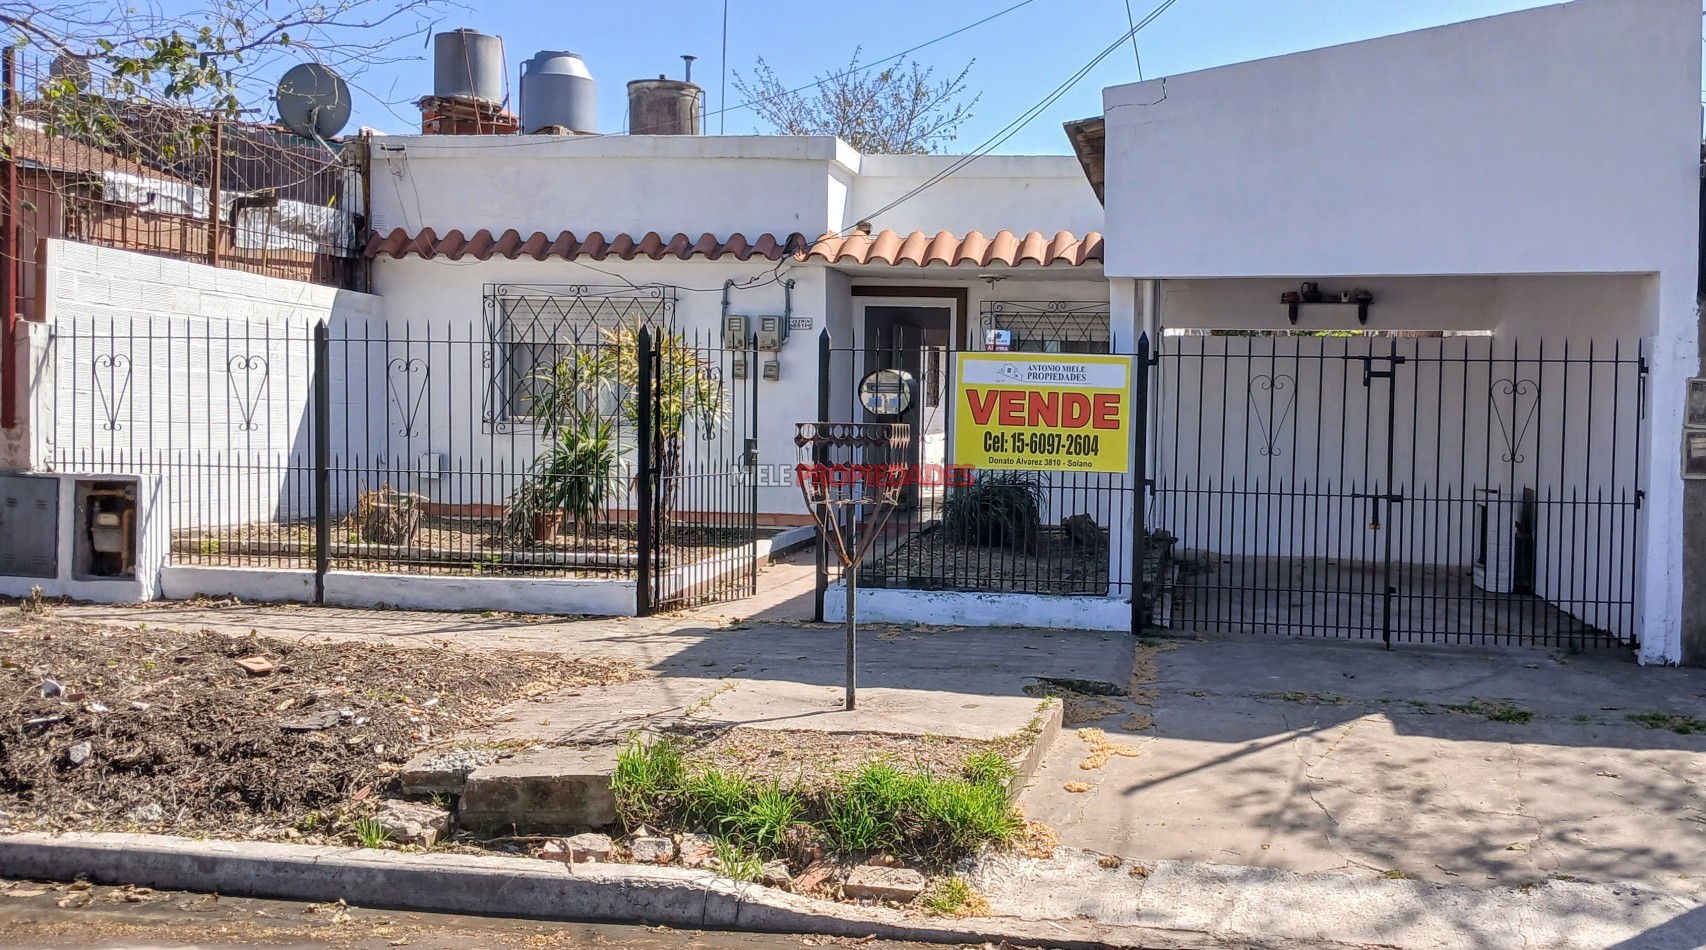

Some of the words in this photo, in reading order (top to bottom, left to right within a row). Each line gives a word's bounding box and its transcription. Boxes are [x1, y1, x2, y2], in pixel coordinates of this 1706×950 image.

[1027, 372, 1087, 382] PROPIEDADES
[966, 389, 1120, 430] VENDE
[984, 431, 1008, 453] Cel:
[1010, 433, 1099, 456] 15-6097-2604
[989, 457, 1014, 465] Donato
[1016, 456, 1042, 466] Álvarez
